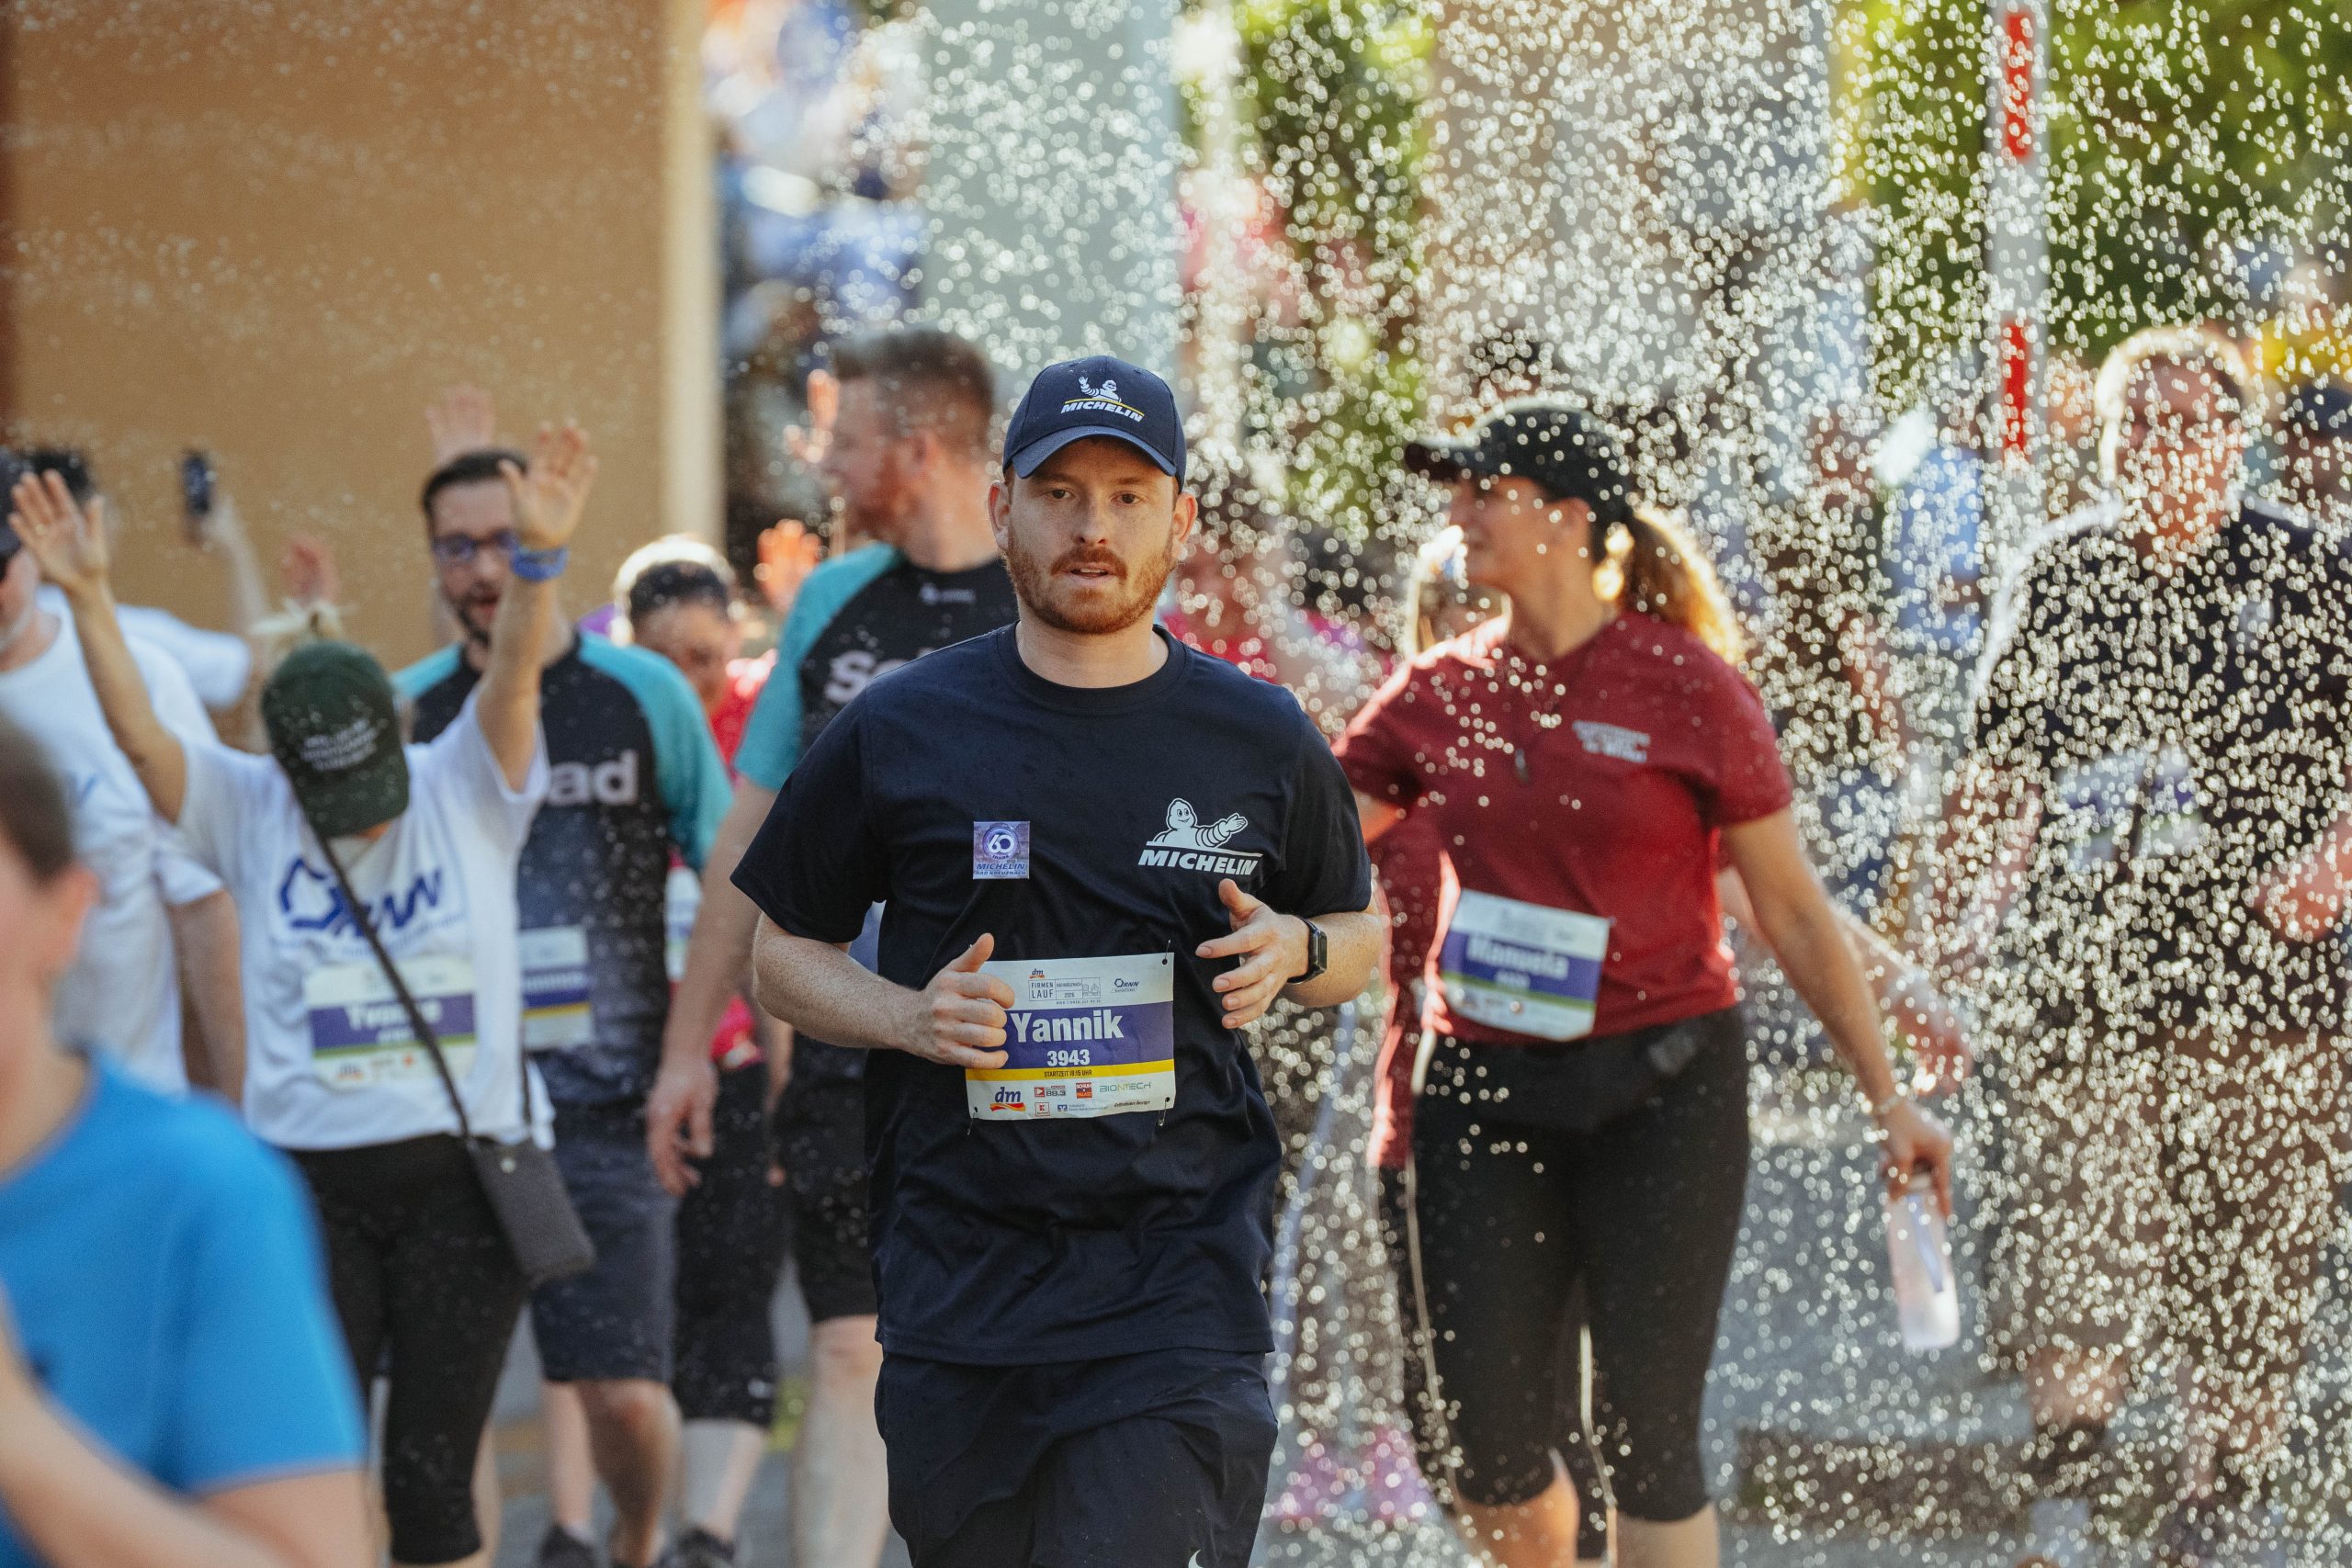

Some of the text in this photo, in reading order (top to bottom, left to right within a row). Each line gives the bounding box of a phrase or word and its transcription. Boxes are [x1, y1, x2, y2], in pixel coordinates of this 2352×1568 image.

[1060, 401, 1144, 423] MICHELIN
[989, 834, 1014, 853] 60
[1138, 849, 1258, 875] MICHELIN
[1032, 989, 1054, 998] LAUF
[1010, 1010, 1125, 1043] Yannik
[1046, 1049, 1091, 1066] 3943
[995, 1086, 1022, 1103] dm
[1099, 1082, 1151, 1092] BIONTECH
